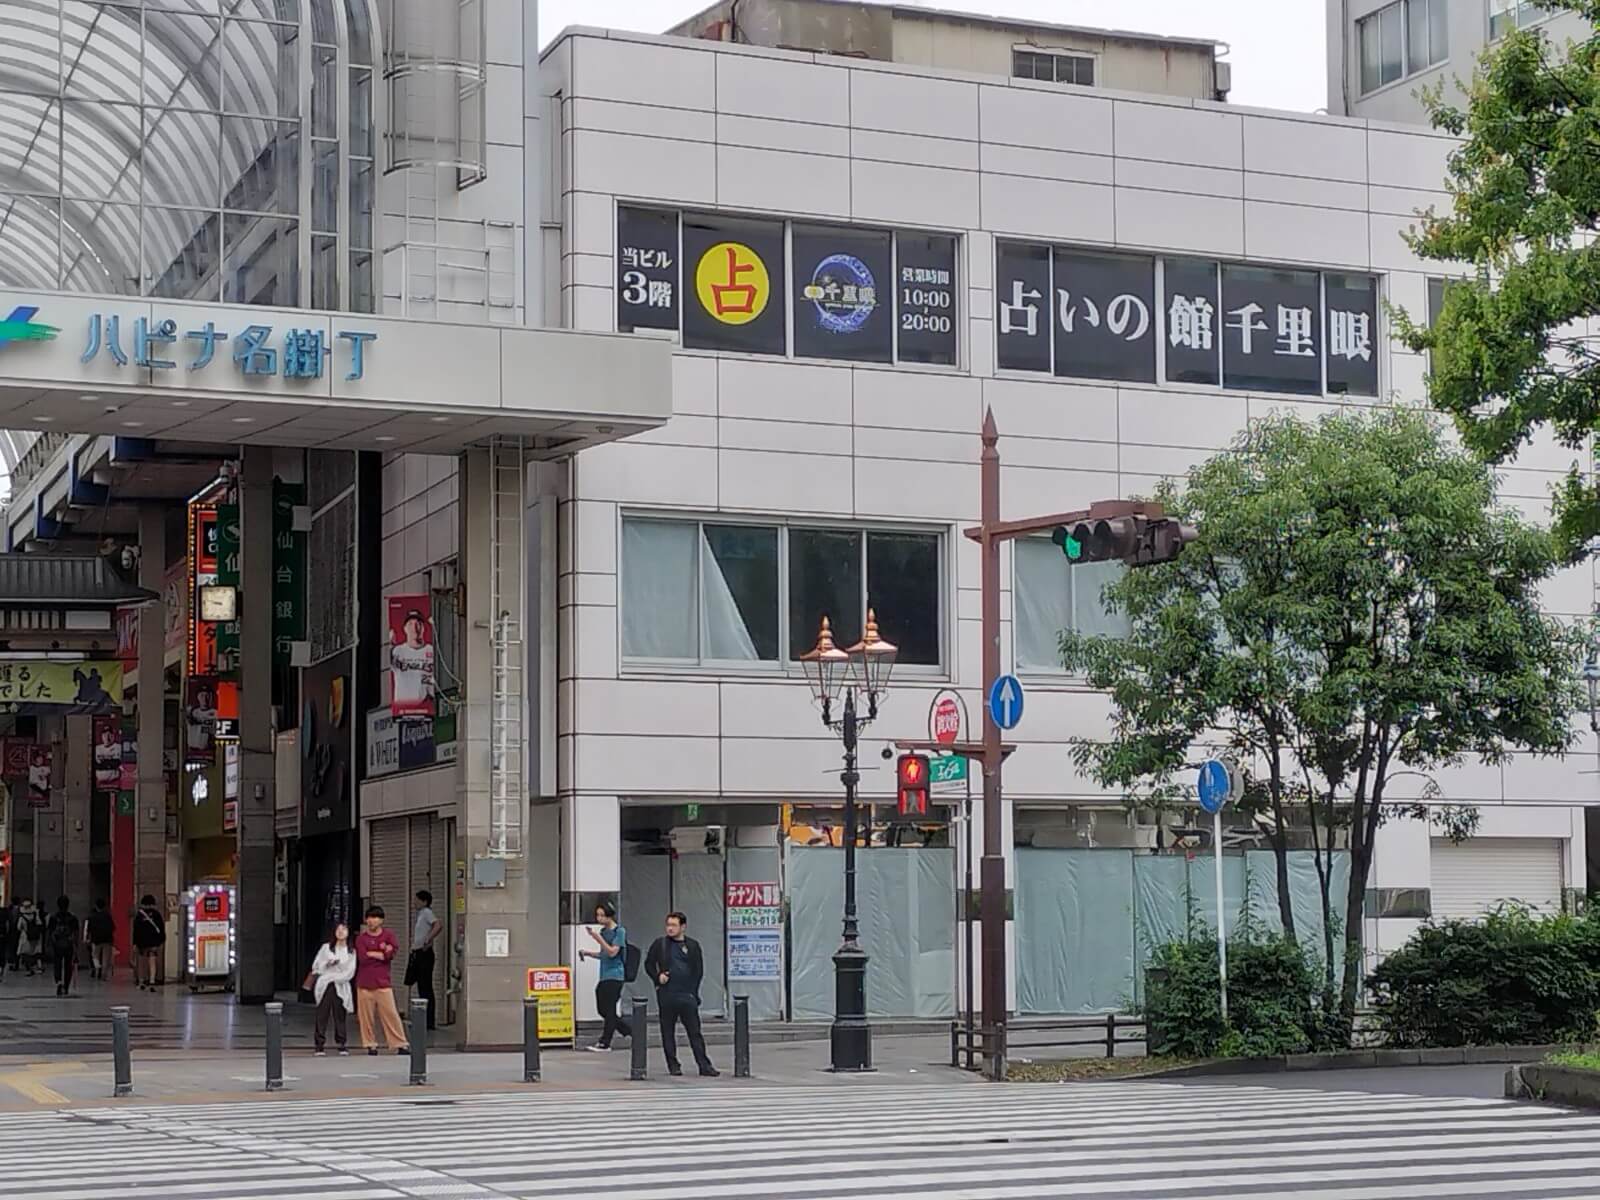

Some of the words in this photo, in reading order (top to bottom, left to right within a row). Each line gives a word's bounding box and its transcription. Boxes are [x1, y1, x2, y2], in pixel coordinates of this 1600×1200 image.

[622, 247, 672, 269] 当ビル
[710, 248, 758, 316] 占
[902, 267, 950, 285] 営業時間
[622, 271, 672, 308] 3階
[903, 288, 950, 309] 10:00
[902, 313, 951, 333] 20:00
[275, 530, 294, 654] 仙台銀行
